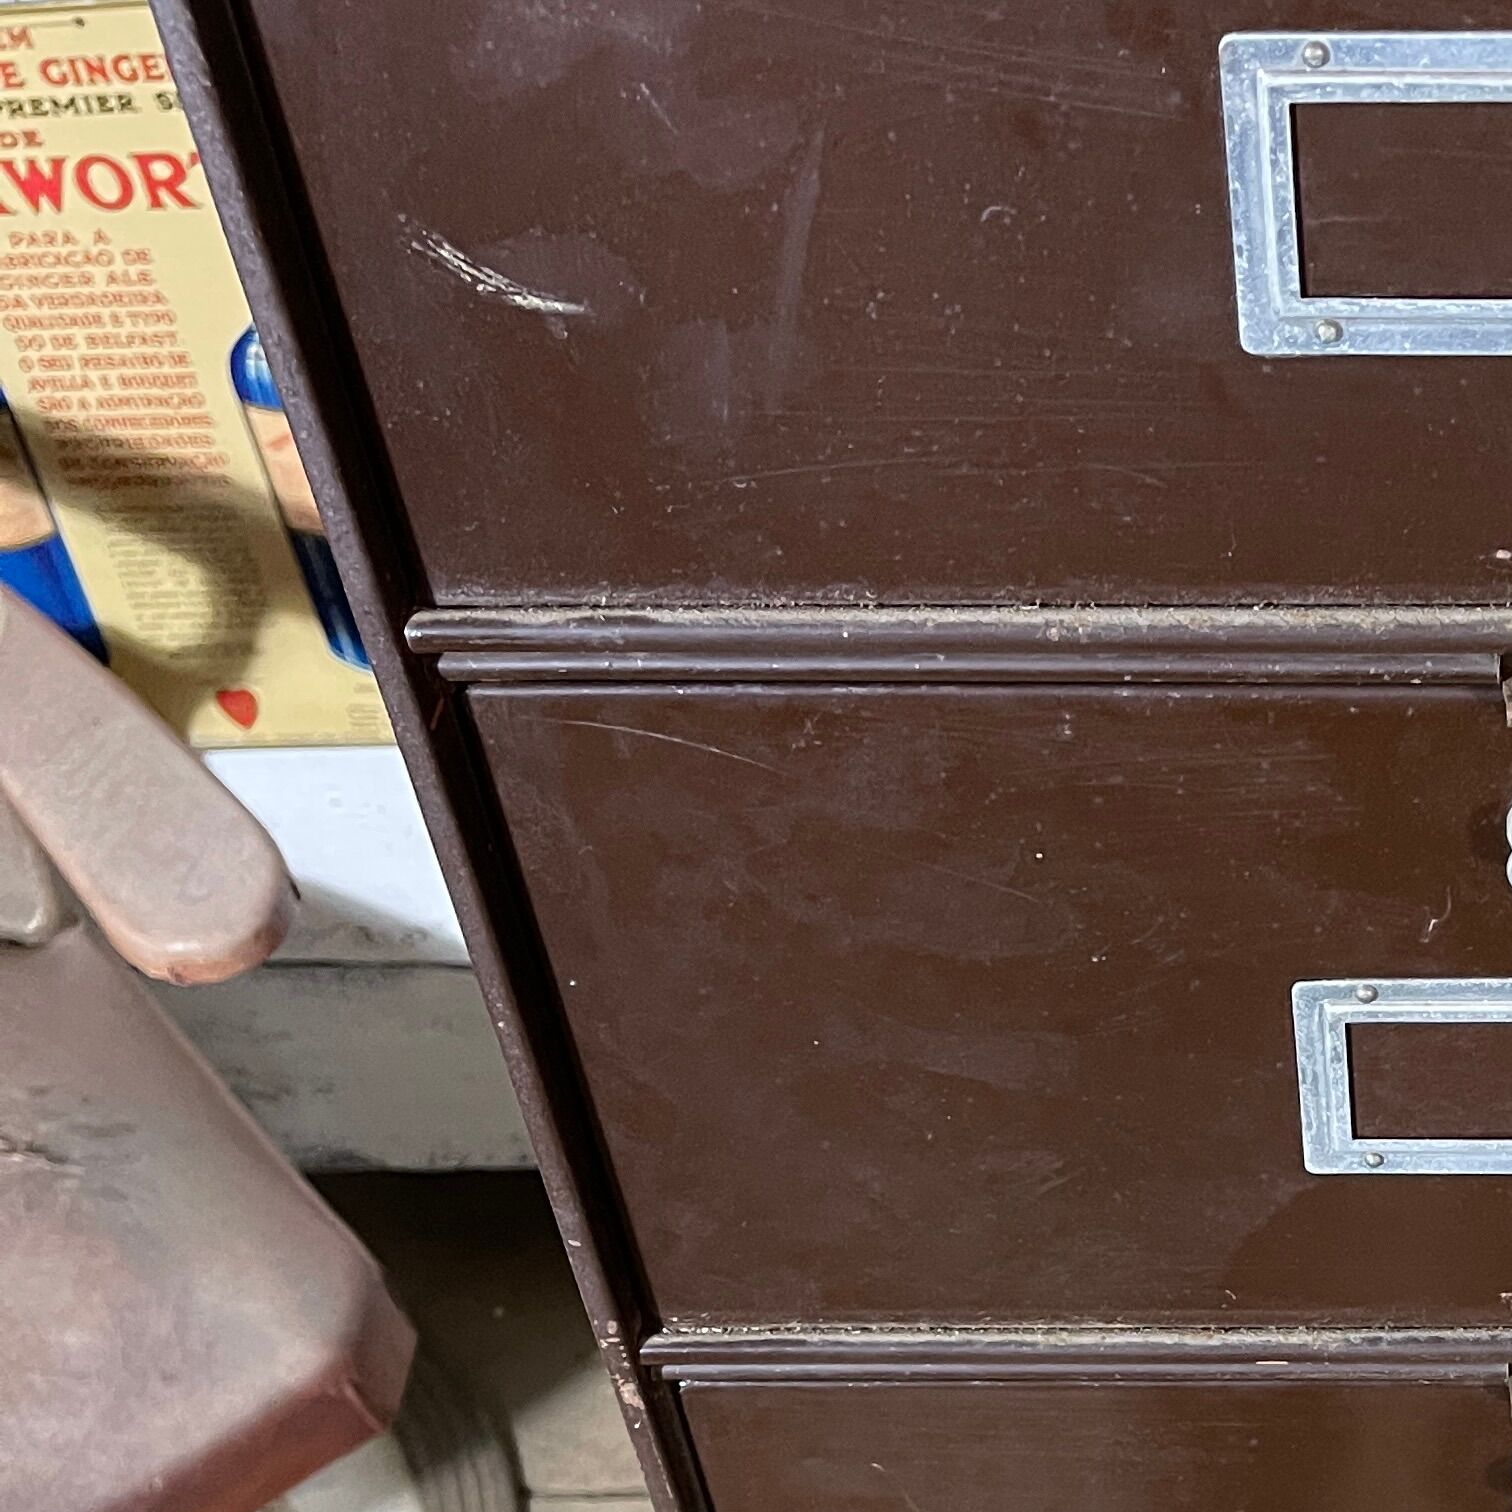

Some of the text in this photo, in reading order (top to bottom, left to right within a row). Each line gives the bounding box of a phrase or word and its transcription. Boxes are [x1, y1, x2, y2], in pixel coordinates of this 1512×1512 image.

[39, 54, 172, 87] GINGE
[0, 152, 204, 215] WOR
[8, 227, 110, 247] PARA A
[106, 269, 156, 288] ALE
